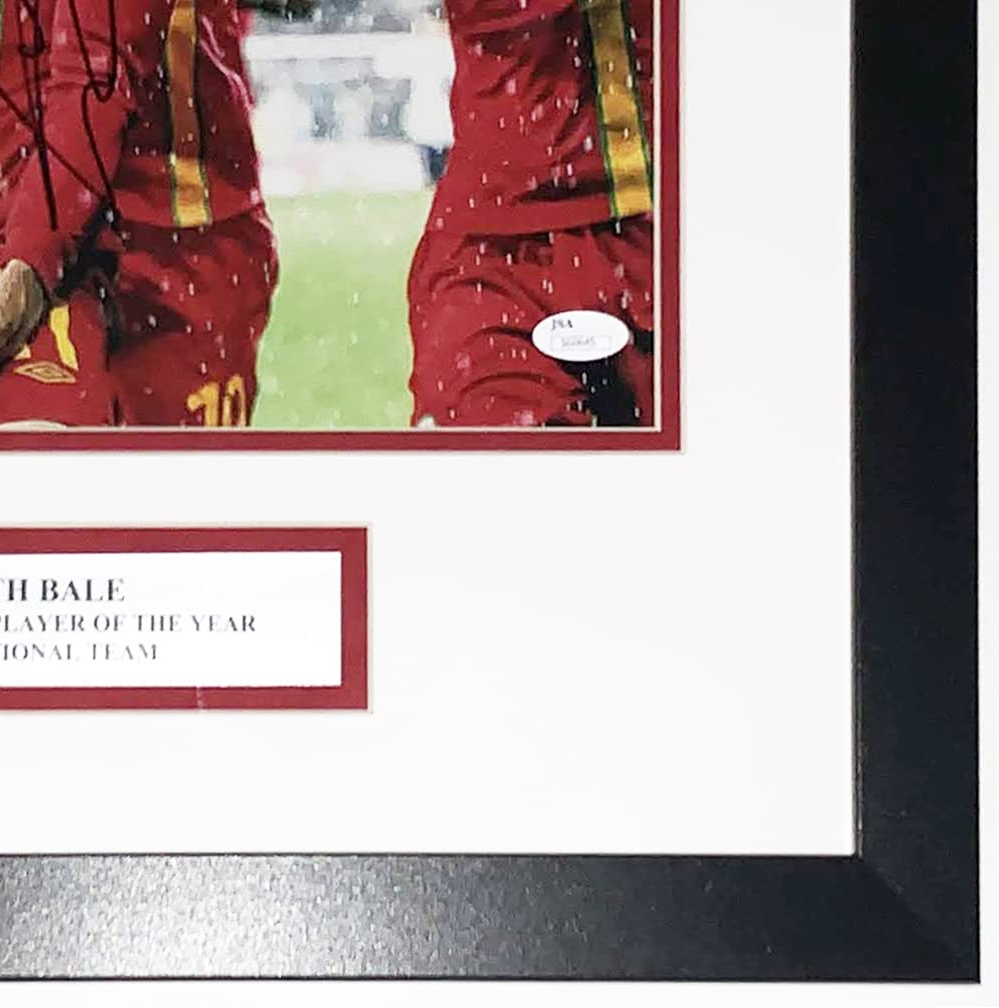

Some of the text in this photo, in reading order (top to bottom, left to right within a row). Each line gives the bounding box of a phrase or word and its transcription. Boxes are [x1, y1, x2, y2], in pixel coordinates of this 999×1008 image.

[40, 577, 126, 602] BALE
[93, 613, 125, 632] OF
[133, 613, 182, 632] THE
[191, 613, 256, 632] YEAR
[88, 643, 157, 661] TEAM
